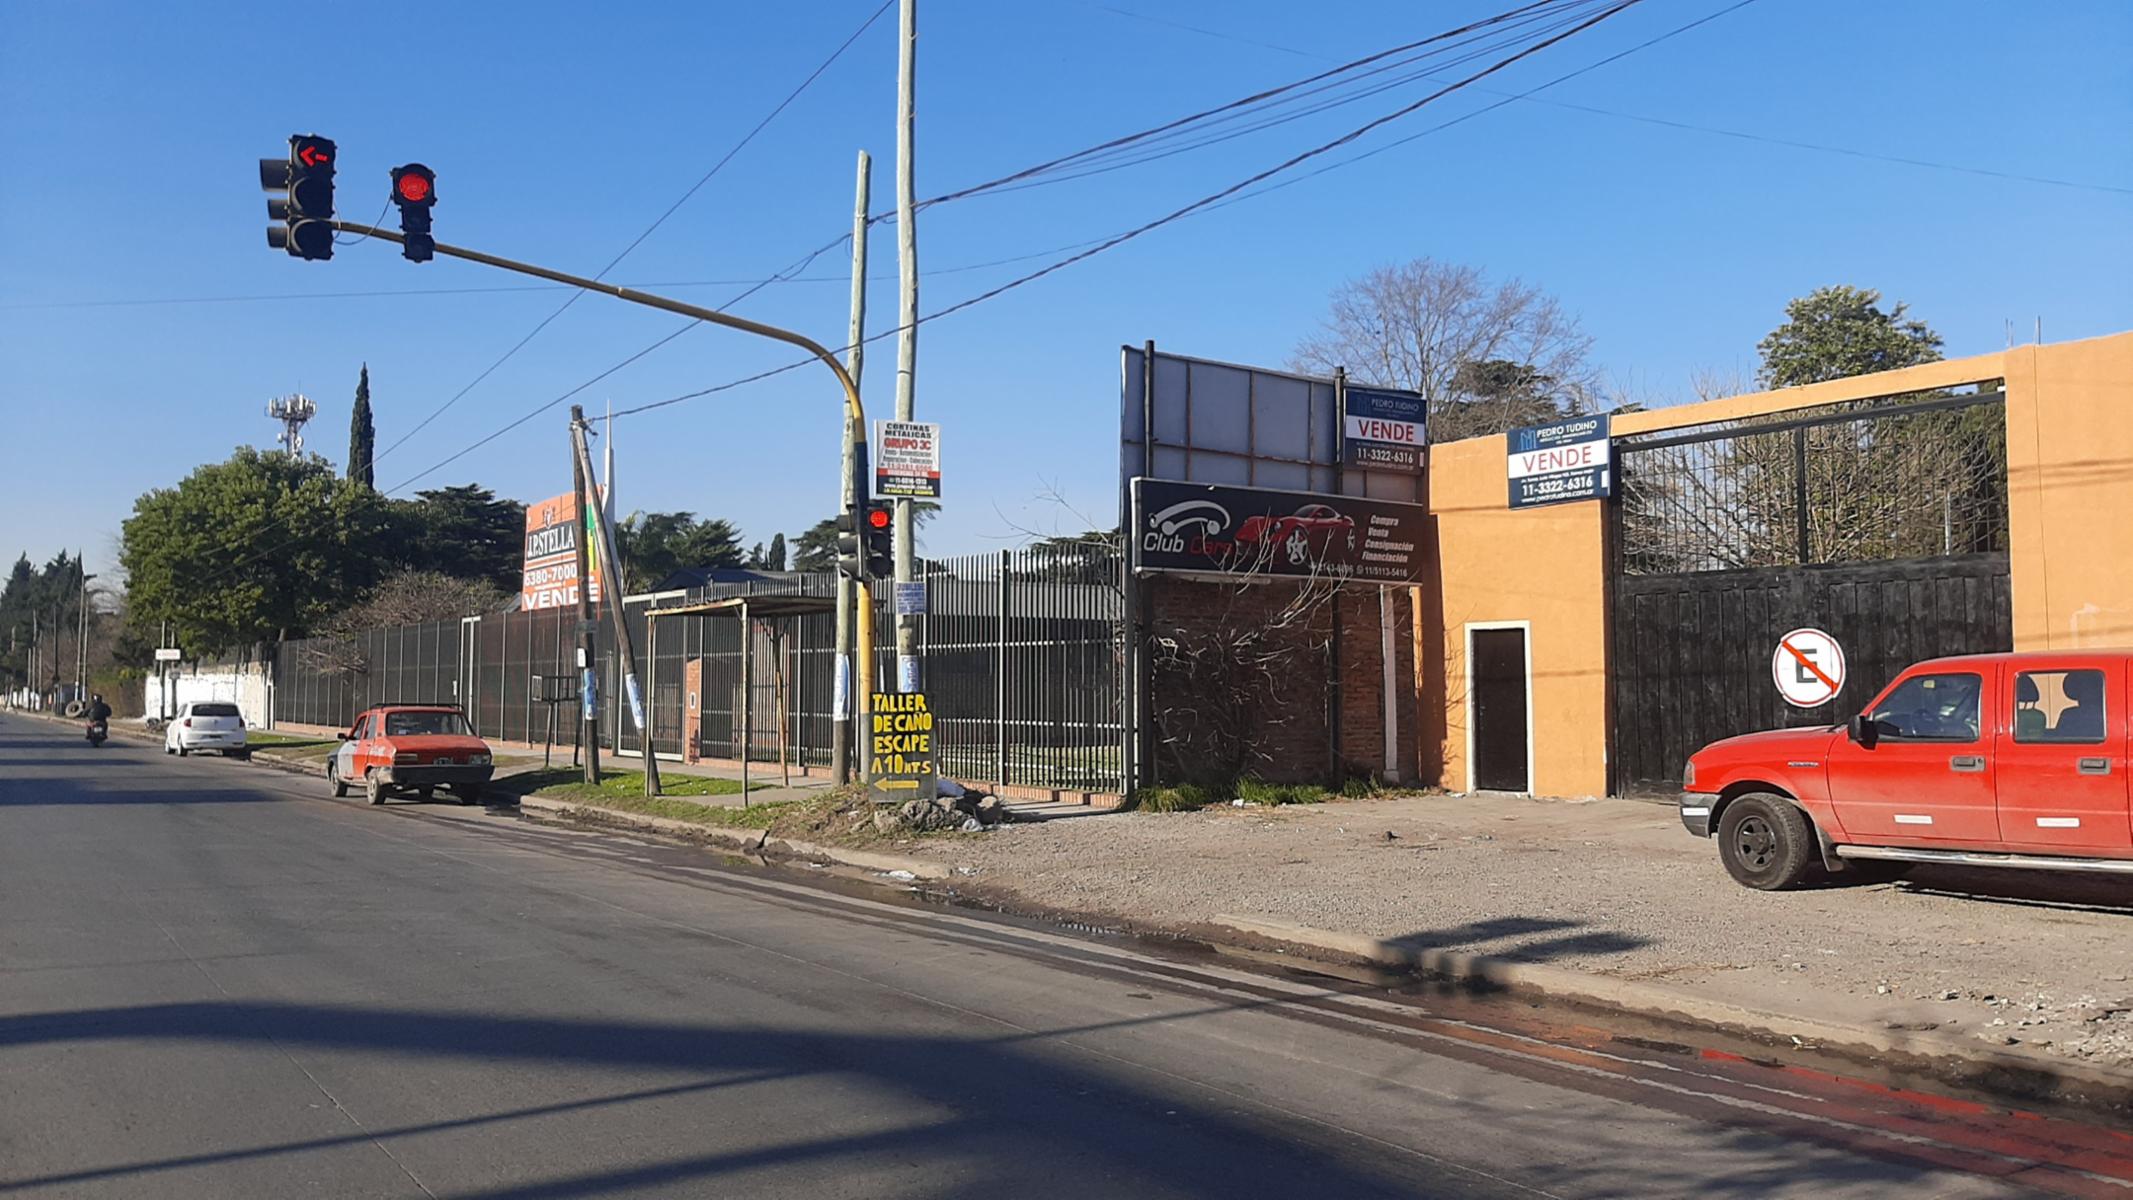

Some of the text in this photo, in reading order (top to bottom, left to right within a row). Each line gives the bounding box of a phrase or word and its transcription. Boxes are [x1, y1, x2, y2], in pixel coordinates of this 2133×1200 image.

[1371, 398, 1393, 409] PEDRO
[885, 430, 932, 439] METALICAS
[886, 422, 930, 432] CORTINAS
[1358, 419, 1414, 442] VENDE
[1536, 426, 1564, 438] PEDRO
[1566, 420, 1597, 433] TUDINO
[884, 437, 932, 450] GRUPO 3C
[1357, 447, 1413, 464] 11-3322-6316
[1522, 445, 1592, 473] VENDE
[1522, 475, 1593, 497] 11-3322-6316
[1370, 514, 1399, 526] Compra
[1367, 526, 1389, 537] Venta
[1143, 532, 1185, 552] Club
[1364, 538, 1414, 552] Consignación
[1361, 551, 1408, 563] Financiación
[1796, 648, 1818, 683] E
[872, 693, 927, 712] TALLER
[873, 714, 893, 733] DE
[874, 734, 930, 754] ESCAPE
[871, 757, 883, 774] A
[884, 753, 904, 774] 10
